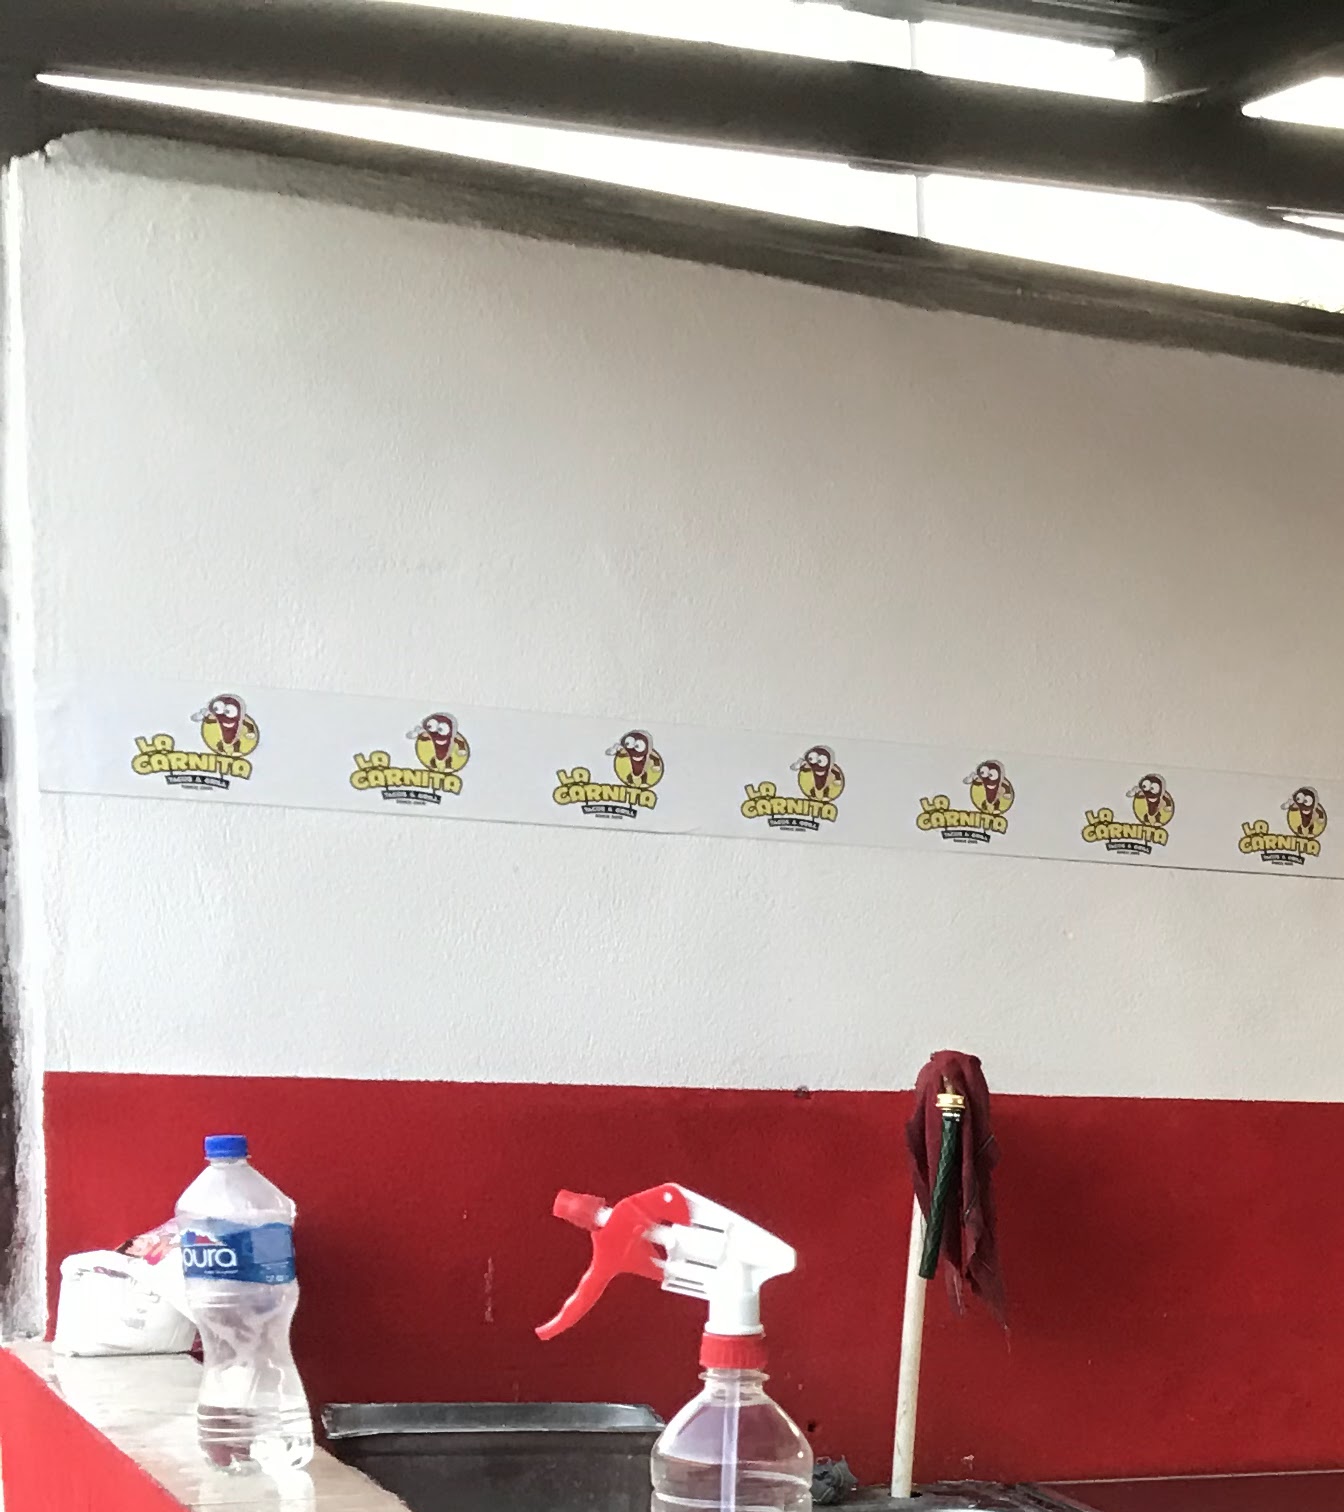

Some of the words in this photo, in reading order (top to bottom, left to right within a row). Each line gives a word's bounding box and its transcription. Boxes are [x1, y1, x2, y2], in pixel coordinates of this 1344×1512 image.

[135, 734, 175, 753] LA
[132, 750, 252, 780] CARNITA
[353, 750, 391, 770] LA
[350, 767, 463, 795] CARNITA
[556, 766, 591, 786] LA
[552, 783, 657, 810] CARNITA
[744, 781, 776, 800] LA
[740, 797, 838, 822] CARNITA
[919, 794, 950, 813] LA
[916, 809, 1008, 834] CARNITA
[1085, 807, 1114, 825] LA
[1082, 821, 1169, 846] CARNITA
[1241, 819, 1269, 837] LA
[1238, 833, 1321, 857] CARNITA
[182, 1248, 237, 1270] pura
